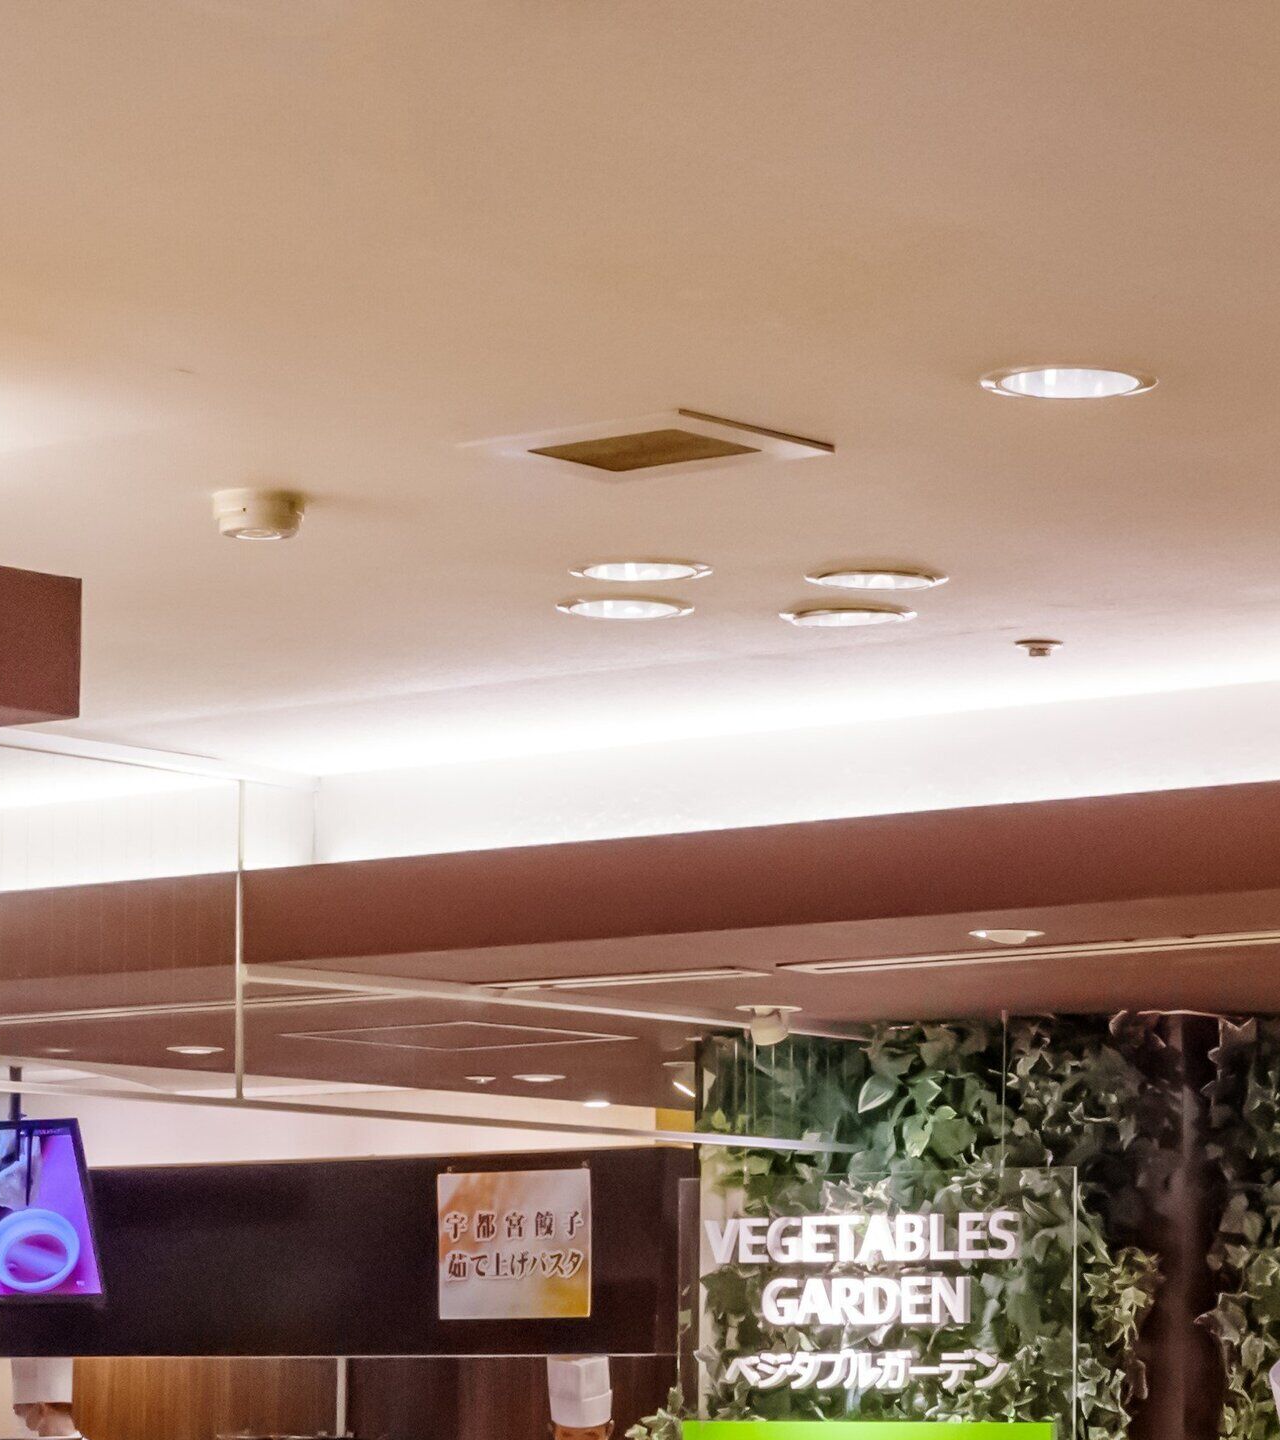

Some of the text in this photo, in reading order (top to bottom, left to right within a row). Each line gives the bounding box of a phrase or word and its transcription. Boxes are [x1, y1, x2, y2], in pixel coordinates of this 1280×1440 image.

[445, 1210, 584, 1242] 宇都宮餃子
[704, 1211, 1019, 1264] VEGETABLES
[447, 1252, 583, 1280] 茹で上げパスタ
[761, 1275, 971, 1326] GARDEN
[724, 1350, 1010, 1391] ベジタブルガーデン
